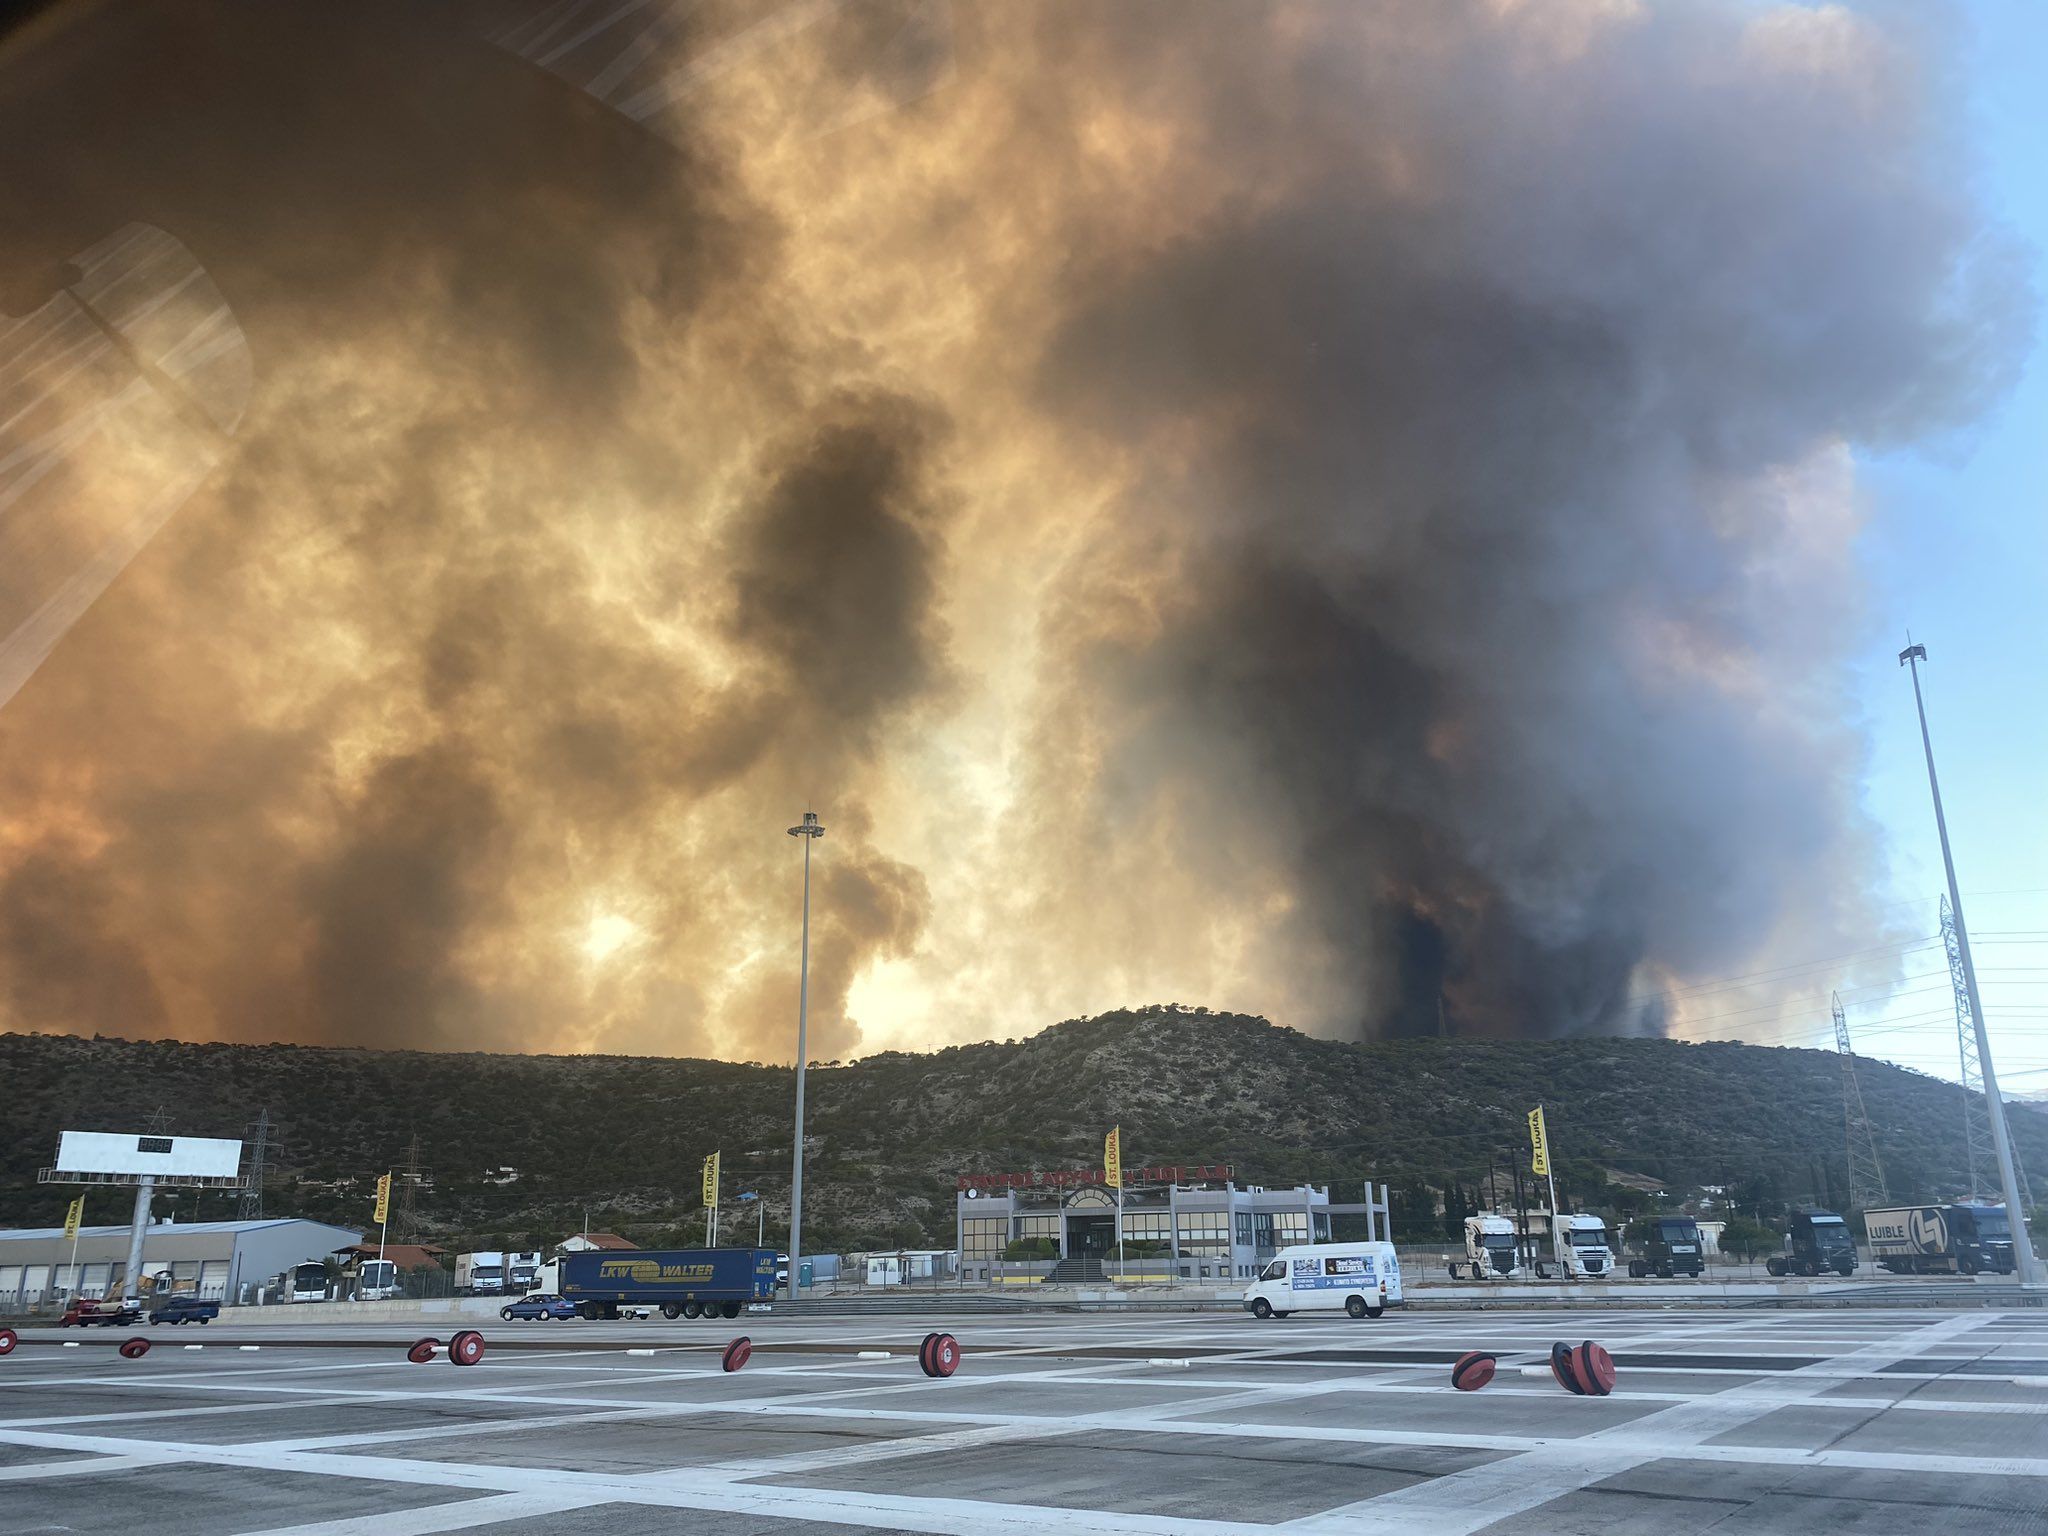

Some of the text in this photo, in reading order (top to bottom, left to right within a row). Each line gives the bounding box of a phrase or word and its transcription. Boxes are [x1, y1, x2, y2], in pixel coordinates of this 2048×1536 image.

[1535, 1152, 1543, 1166] ST.
[1109, 1167, 1117, 1180] ST.
[705, 1188, 713, 1200] ST.
[69, 1200, 79, 1224] LOUKA
[1869, 1225, 1905, 1240] LUIBLE
[600, 1264, 714, 1278] LKW WALTER
